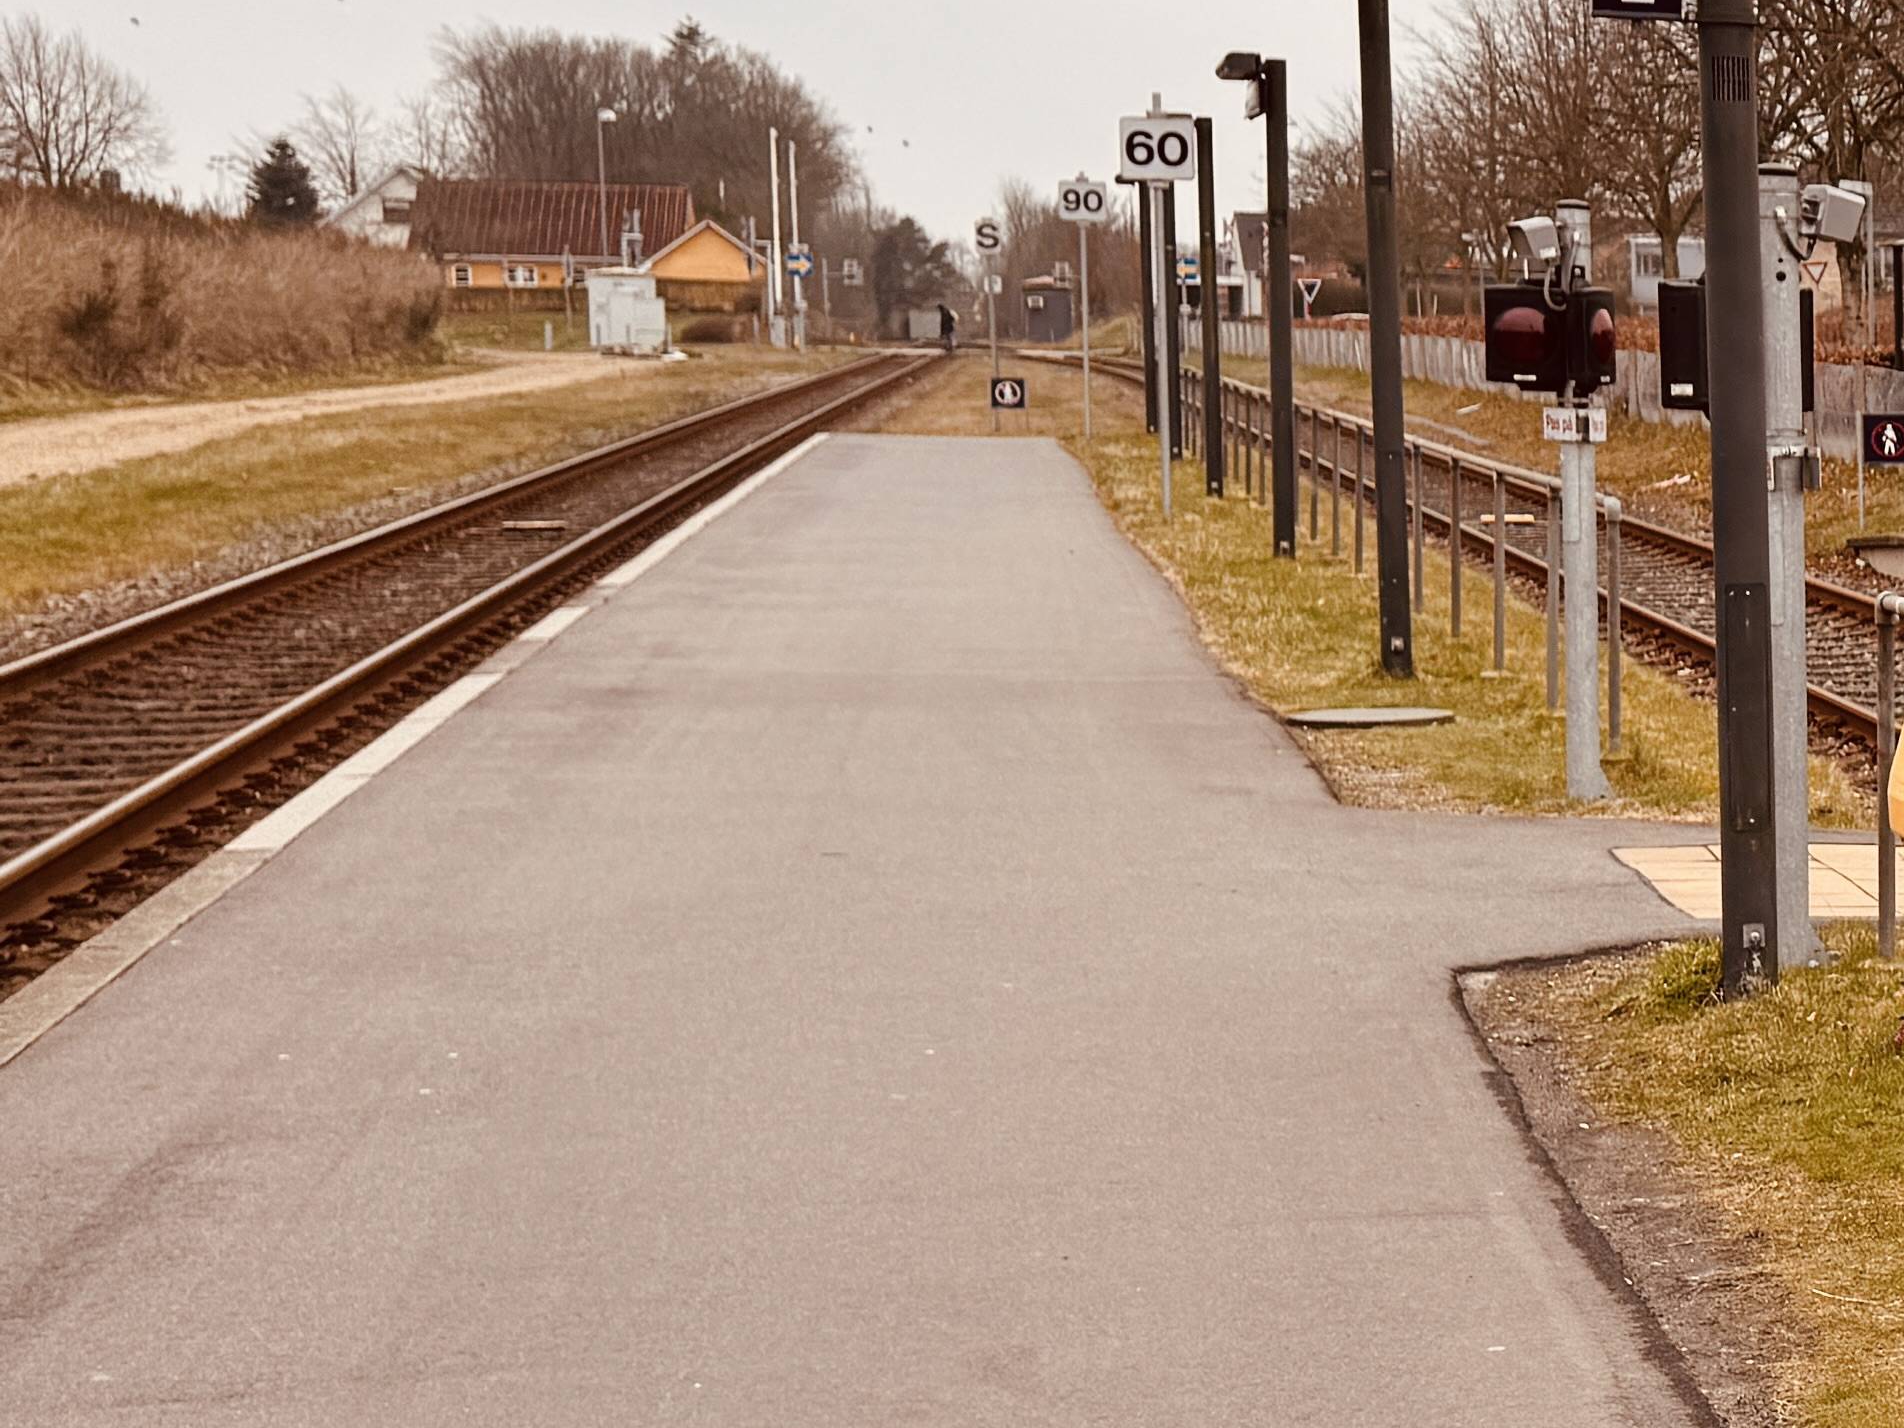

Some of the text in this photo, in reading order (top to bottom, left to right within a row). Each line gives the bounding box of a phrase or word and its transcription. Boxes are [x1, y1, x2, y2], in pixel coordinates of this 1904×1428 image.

[1125, 130, 1189, 167] 60
[1062, 189, 1104, 212] 90
[976, 223, 1000, 249] S
